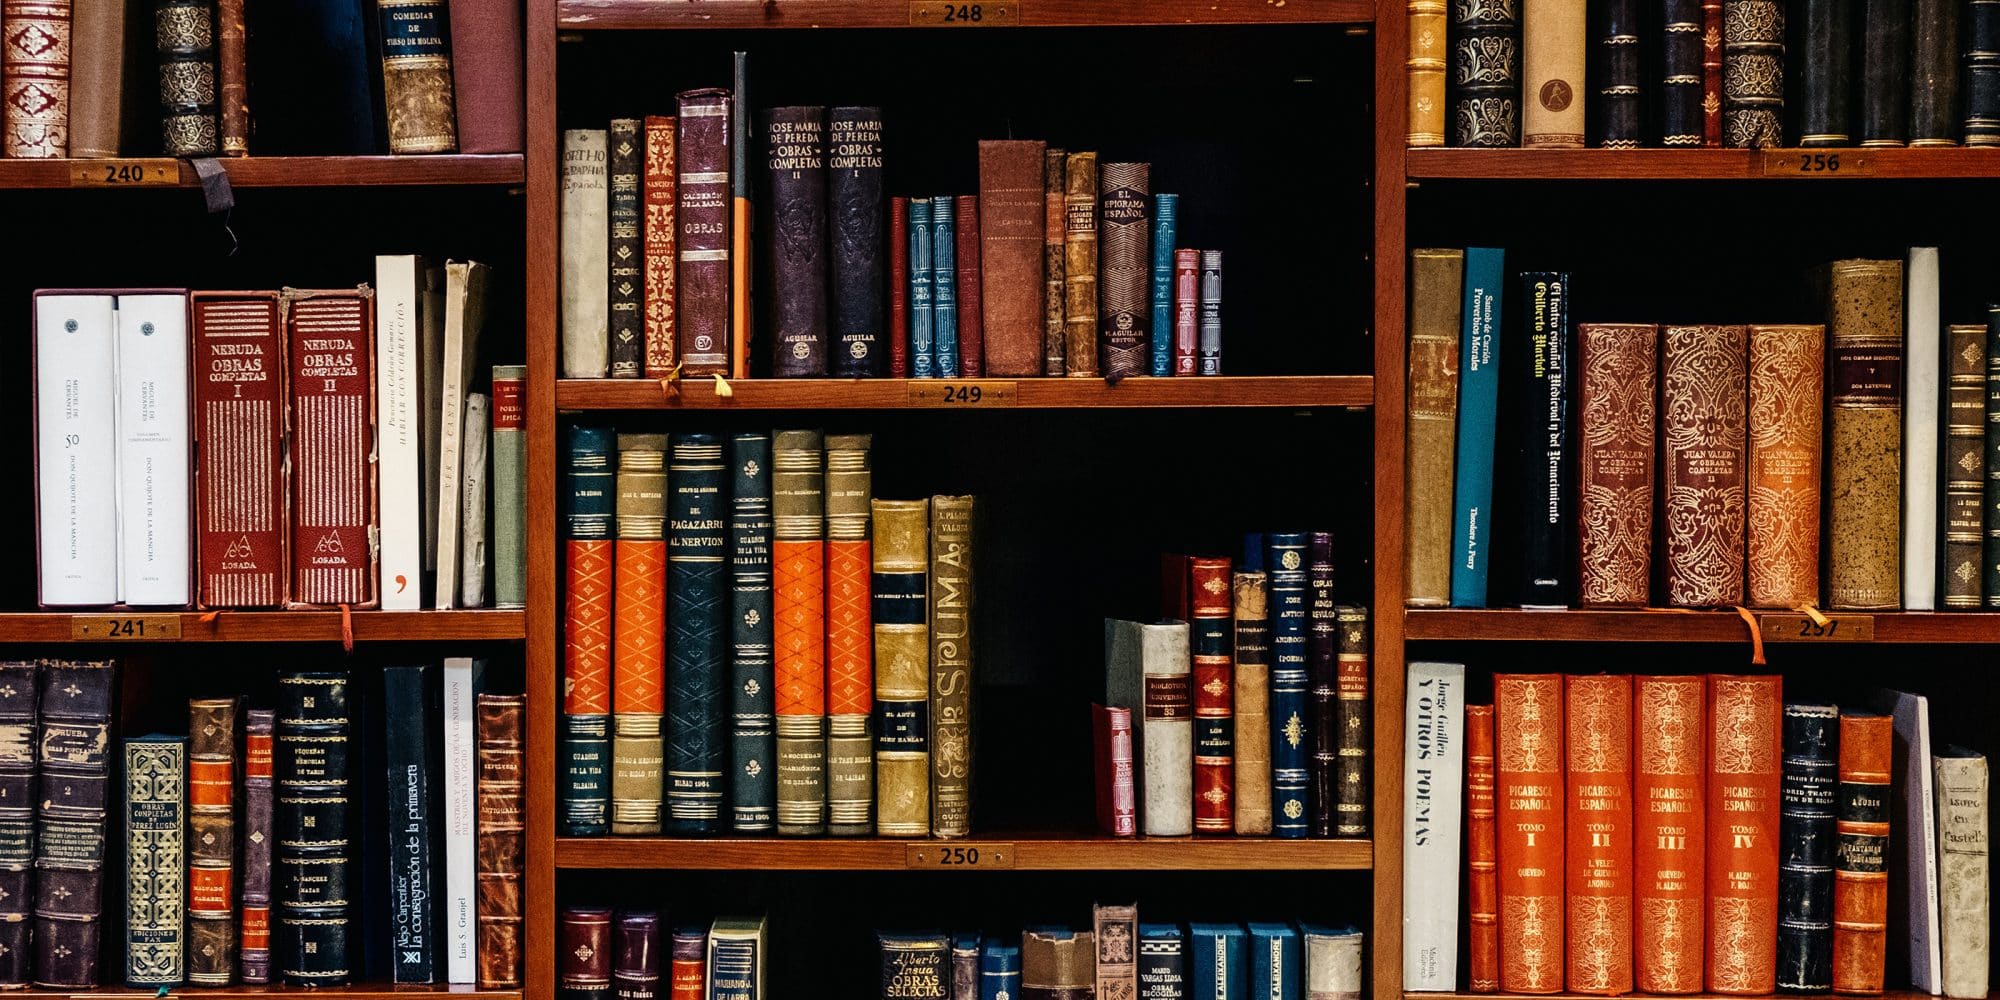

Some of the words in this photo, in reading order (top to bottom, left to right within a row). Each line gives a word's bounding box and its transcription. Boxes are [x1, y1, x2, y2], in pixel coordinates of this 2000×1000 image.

[393, 12, 433, 20] COMEDIAS
[944, 5, 983, 22] 248
[408, 24, 420, 32] DE
[830, 121, 854, 131] JOSE
[856, 121, 883, 130] MARIA
[770, 133, 783, 143] DE
[784, 132, 820, 143] PEREDA
[832, 132, 843, 142] DE
[846, 132, 880, 142] PEREDA
[565, 149, 606, 162] ORTHO
[777, 146, 812, 157] OBRAS
[839, 144, 873, 156] OBRAS
[769, 158, 822, 170] COMPLETAS
[830, 156, 882, 168] COMPLETAS
[1800, 154, 1839, 172] 256
[105, 164, 143, 183] 240
[854, 170, 860, 178] I
[1118, 190, 1131, 199] EL
[1104, 200, 1145, 209] EPIGRAMA
[1104, 208, 1144, 218] ESPAÑOL
[685, 223, 723, 234] OBRAS
[1550, 282, 1561, 296] El
[1472, 288, 1484, 334] Proverbios
[1483, 295, 1493, 323] Santob
[1550, 298, 1560, 328] teatro
[1483, 323, 1492, 334] de
[784, 334, 819, 343] AGUILAR
[842, 334, 876, 342] AGUILAR
[211, 344, 264, 355] NERUDA
[303, 339, 356, 351] NERUDA
[1482, 334, 1491, 365] Carrión
[1548, 331, 1561, 370] español
[1471, 336, 1481, 371] Morales
[211, 358, 262, 372] OBRAS
[303, 353, 353, 367] OBRAS
[209, 372, 267, 382] COMPLETAS
[301, 366, 358, 377] COMPLETAS
[234, 384, 242, 397] I
[323, 379, 337, 392] II
[943, 386, 982, 403] 249
[1548, 374, 1561, 421] Medieval
[1550, 433, 1560, 447] del
[1683, 450, 1706, 459] JUAN
[1707, 450, 1736, 459] VALERA
[1759, 451, 1781, 459] JUAN
[1700, 459, 1725, 467] OBRAS
[1599, 466, 1644, 474] COMPLETAS
[1688, 466, 1733, 474] COMPLETAS
[1708, 475, 1716, 483] II
[1547, 451, 1560, 523] Renacimiento
[147, 507, 153, 517] DE
[147, 519, 153, 528] LA
[671, 519, 724, 530] PAGAZARRI
[1469, 506, 1478, 540] Theodore
[670, 536, 680, 546] AL
[682, 537, 724, 547] NERVION
[1469, 540, 1476, 549] A.
[222, 561, 257, 570] LOSADA
[312, 557, 348, 565] LOSADA
[1466, 550, 1476, 570] Perry
[109, 620, 144, 637] 241
[936, 542, 969, 727] ESPUMA
[1418, 678, 1433, 688] Y
[1417, 697, 1433, 760] OTROS
[64, 785, 72, 796] 2
[406, 764, 423, 820] primavera
[1509, 785, 1552, 797] PICARESCA
[1579, 785, 1621, 797] PICARESCA
[1650, 787, 1693, 799] PICARESCA
[1724, 786, 1767, 798] PICARESCA
[141, 803, 165, 811] OBRAS
[1415, 769, 1432, 847] POEMAS
[1509, 798, 1551, 810] ESPAÑOLA
[1579, 798, 1620, 810] ESPAÑOLA
[1650, 799, 1692, 813] ESPAÑOLA
[134, 810, 174, 818] COMPLETAS
[405, 823, 419, 833] la
[1516, 823, 1545, 832] TOMO
[1586, 823, 1615, 832] TOMO
[1656, 826, 1686, 835] TOMO
[1730, 825, 1759, 834] TOMO
[406, 836, 420, 854] de
[1526, 833, 1536, 847] I
[1591, 833, 1611, 847] II
[1656, 836, 1687, 850] III
[1733, 835, 1757, 849] IV
[941, 847, 980, 864] 250
[396, 875, 409, 924] Carpentier
[407, 856, 425, 933] consagración
[457, 897, 468, 928] Granjel
[132, 930, 174, 938] EDICIONES
[398, 925, 411, 948] Alejo
[408, 936, 422, 949] La
[457, 942, 467, 960] Luis
[892, 952, 941, 965] Alberto
[899, 963, 935, 975] Insua
[1217, 938, 1225, 992] ALEIXANDRE
[1271, 939, 1280, 993] ALEIXANDRE
[892, 975, 940, 987] OBRAS
[1141, 974, 1164, 983] VARGAS
[1164, 974, 1182, 983] LLOSA
[887, 985, 946, 997] SELECTAS
